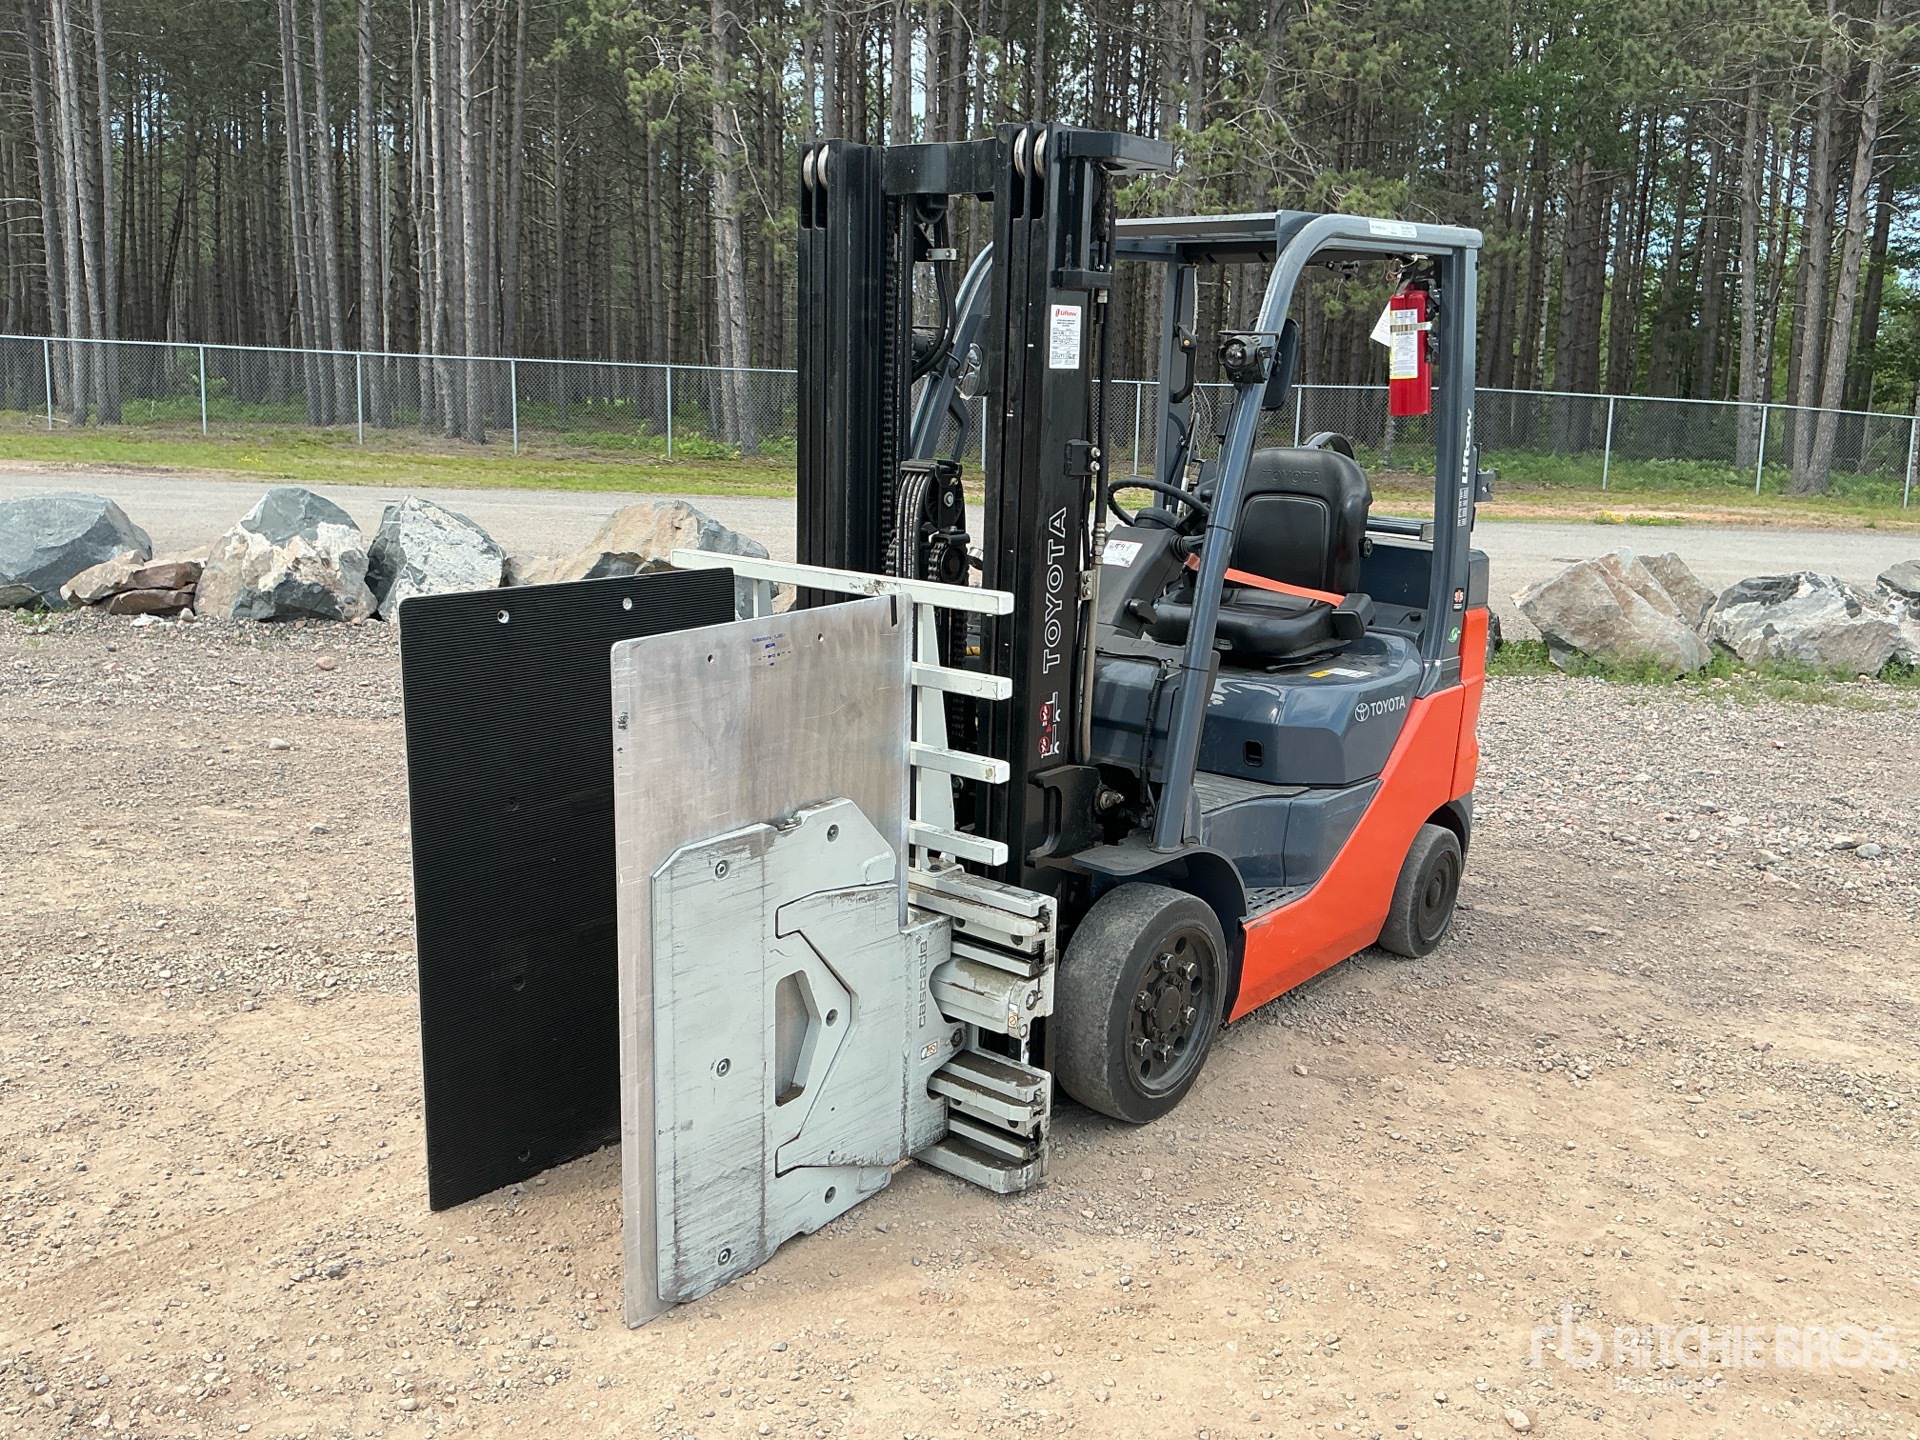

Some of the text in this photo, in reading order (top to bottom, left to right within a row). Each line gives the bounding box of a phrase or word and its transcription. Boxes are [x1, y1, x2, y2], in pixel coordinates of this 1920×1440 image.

[1262, 468, 1322, 486] TOYOTA
[1042, 506, 1067, 675] TOYOTA
[1370, 695, 1406, 717] TOYOTA
